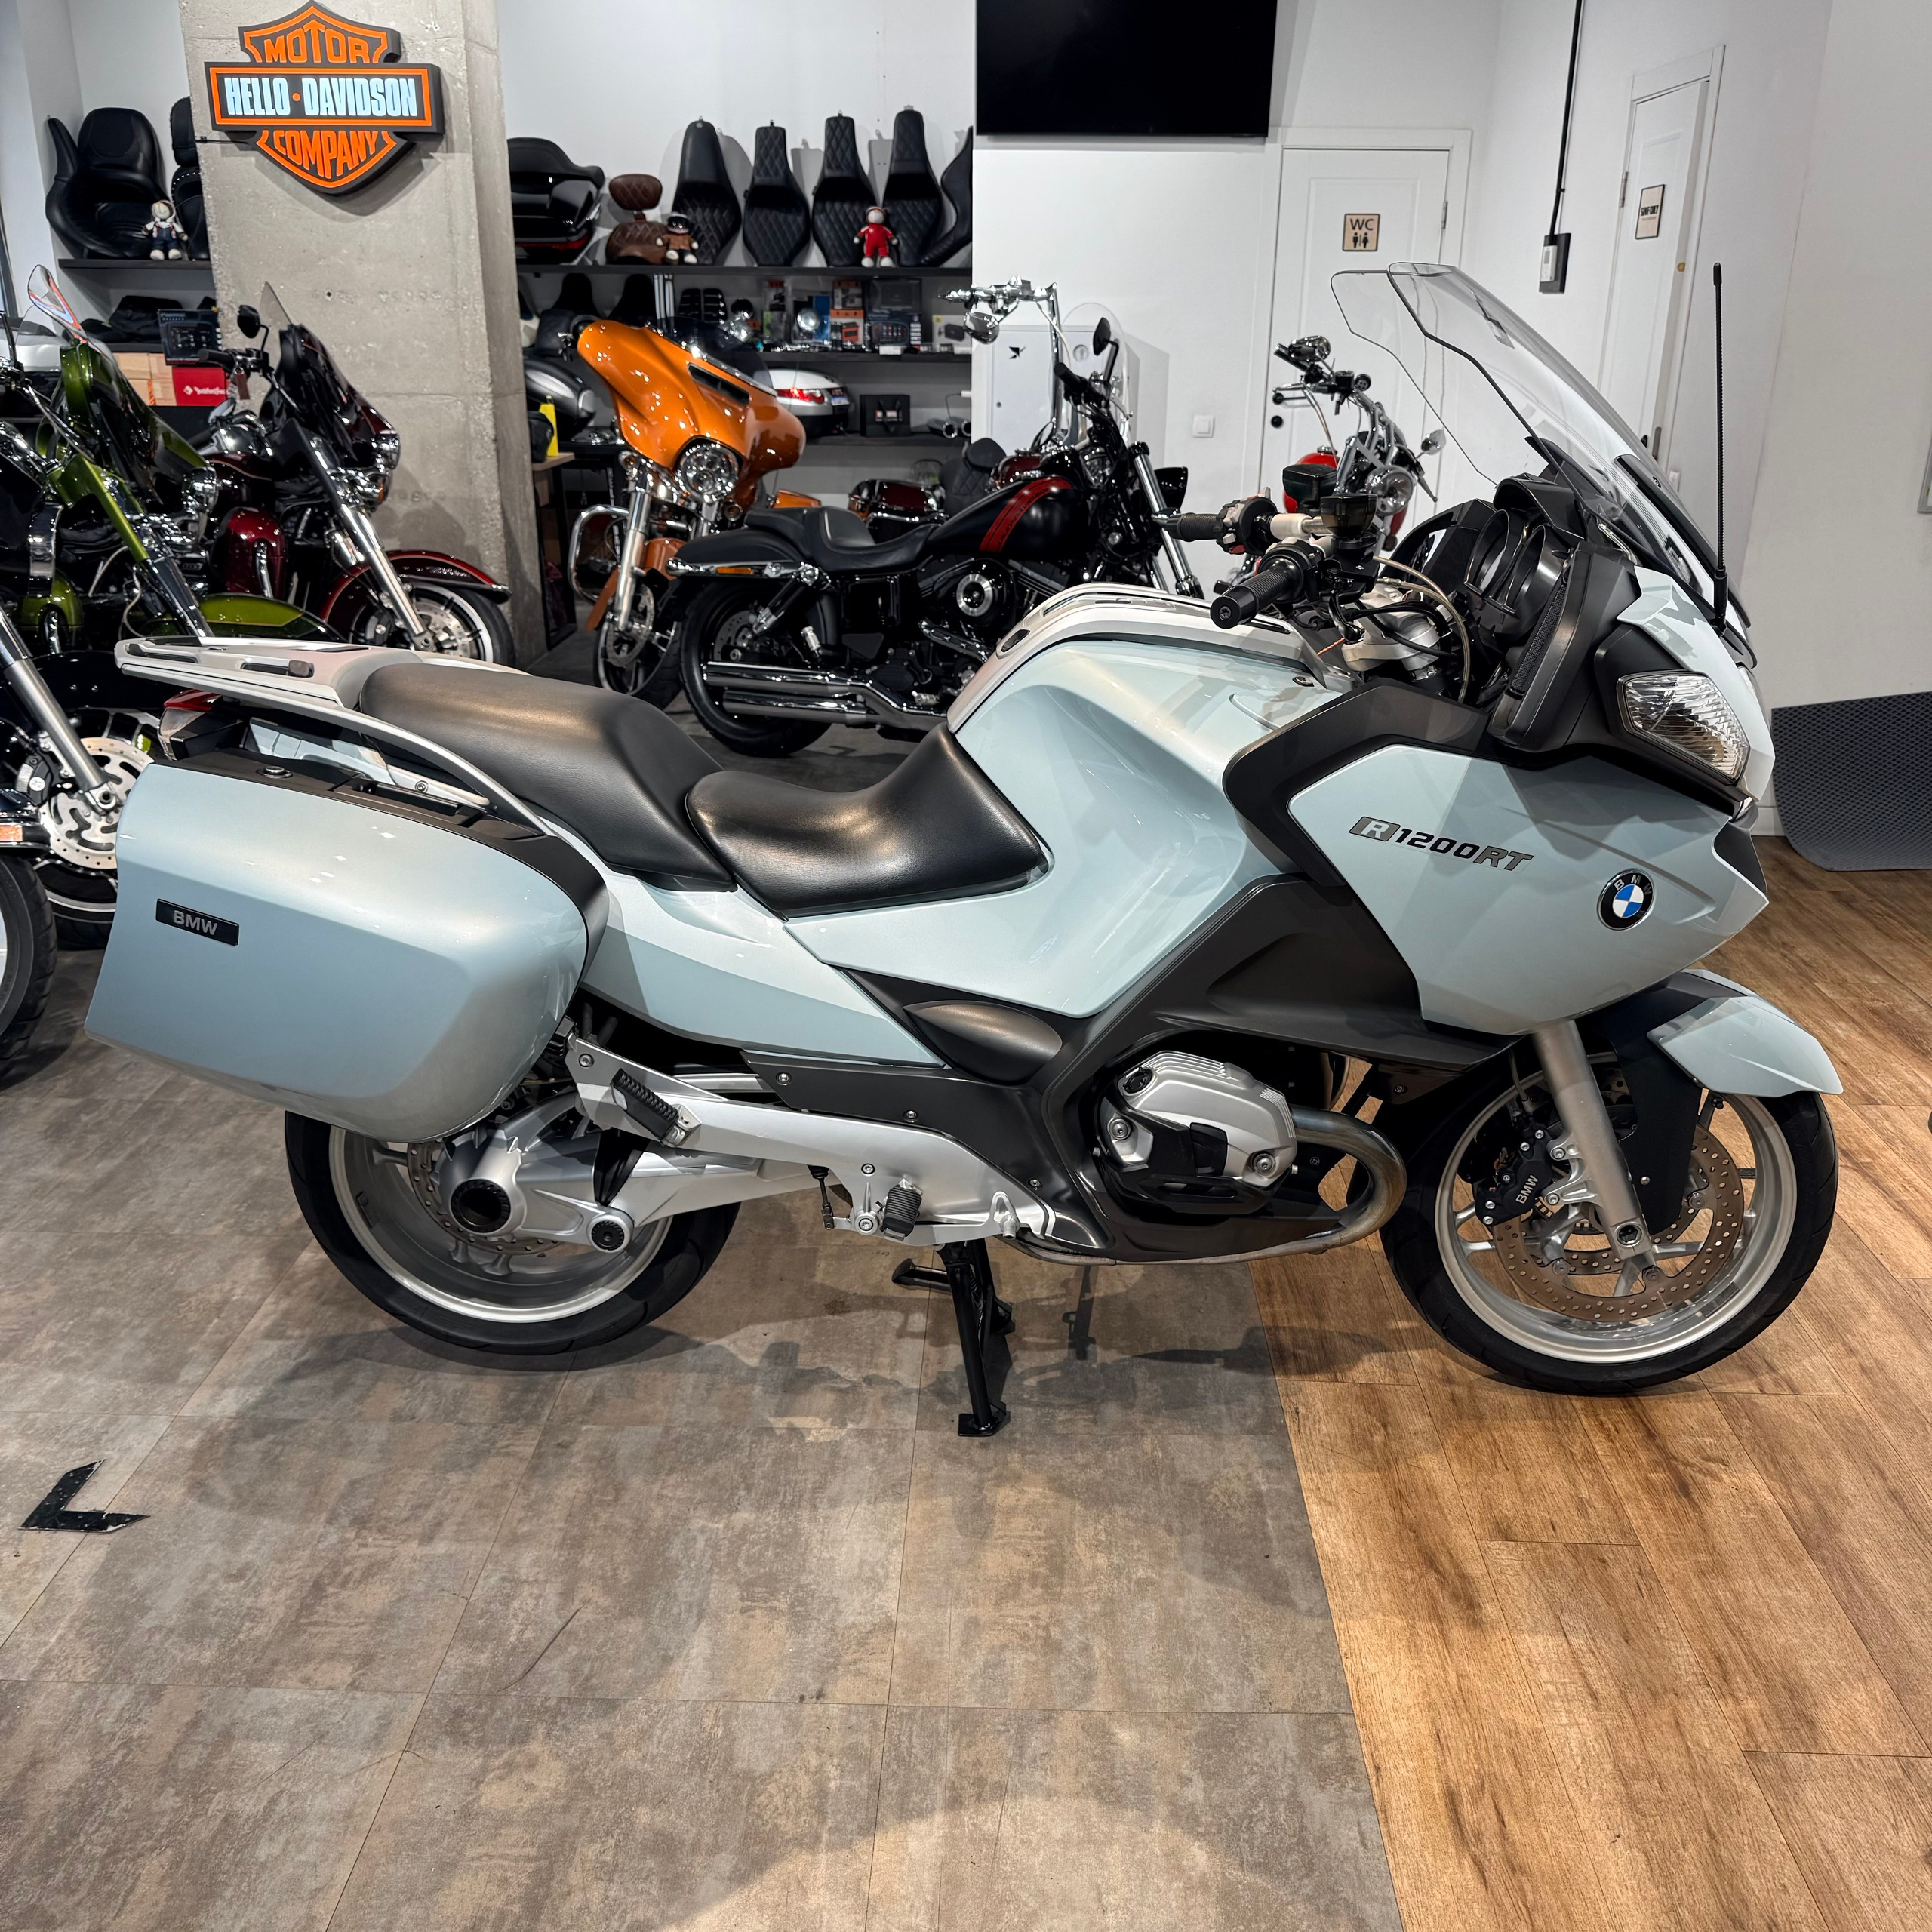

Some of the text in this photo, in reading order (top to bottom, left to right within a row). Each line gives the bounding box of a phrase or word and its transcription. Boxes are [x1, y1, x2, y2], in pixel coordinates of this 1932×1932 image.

[263, 19, 371, 63] MOTOR
[223, 77, 417, 116] HELLO DAVIDSON
[273, 129, 378, 179] COMPANY
[1349, 218, 1374, 231] WC
[1614, 874, 1652, 895] BMW
[173, 909, 218, 936] BMW
[1515, 1174, 1539, 1204] BMW
